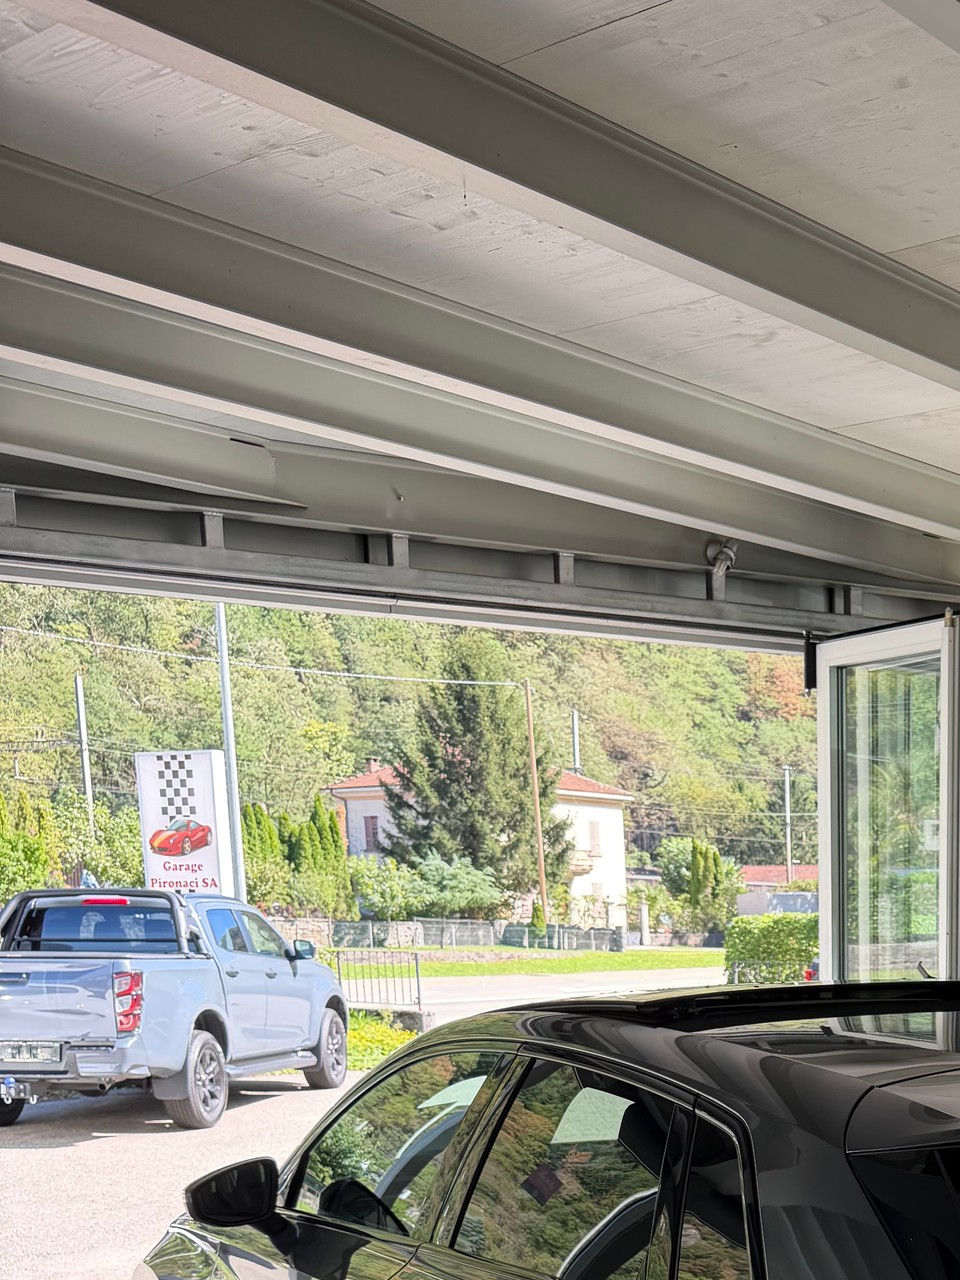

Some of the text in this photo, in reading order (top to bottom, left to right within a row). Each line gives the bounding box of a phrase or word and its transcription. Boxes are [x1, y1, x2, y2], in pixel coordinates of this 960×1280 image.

[163, 861, 203, 873] Garage
[150, 877, 218, 888] Pironaci SA
